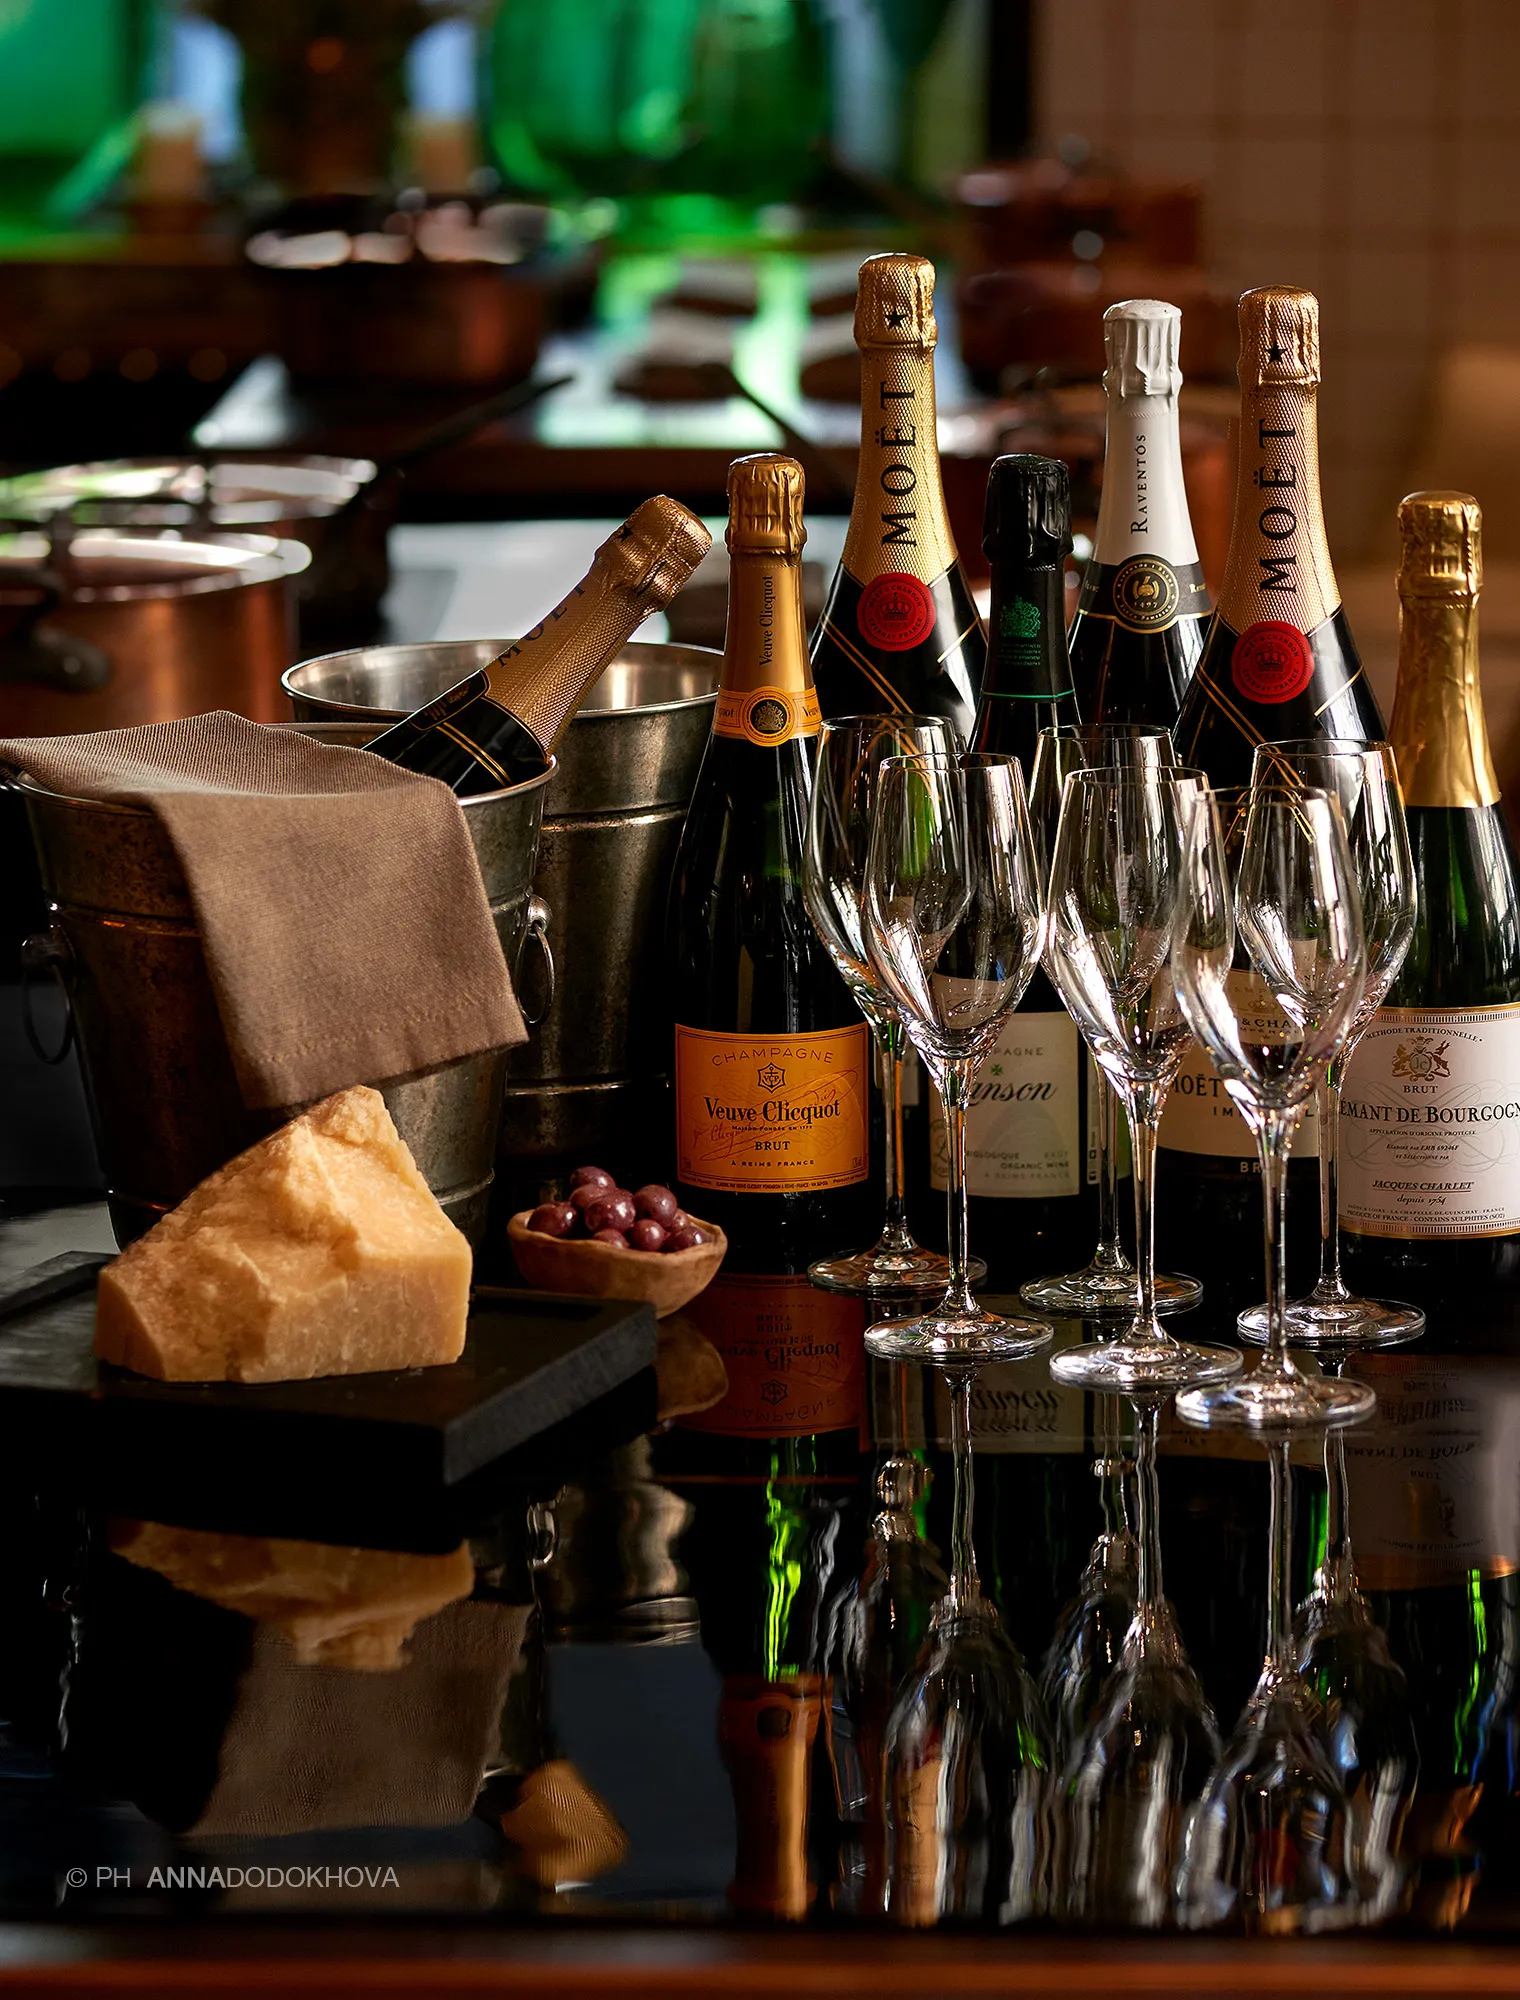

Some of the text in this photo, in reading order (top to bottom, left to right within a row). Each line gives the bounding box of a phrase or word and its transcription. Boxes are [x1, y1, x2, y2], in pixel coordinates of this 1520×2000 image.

[875, 380, 917, 547] MOËT
[1131, 434, 1149, 534] RAVENTÓS
[1253, 418, 1297, 594] MOËT
[759, 575, 776, 667] Veuve Clicquot
[1405, 1027, 1479, 1042] TRADITIONNELLE
[711, 1047, 834, 1067] CHAMPAGNE
[993, 1047, 1044, 1056] PAGNE
[969, 1081, 1059, 1106] anson
[1403, 1085, 1438, 1094] BRUT
[703, 1097, 841, 1125] Veuve Clicquot
[1340, 1097, 1393, 1122] ÉMANT
[1396, 1107, 1421, 1123] DE
[755, 1141, 790, 1151] BRUT
[1000, 1162, 1043, 1170] ORGANIC
[1240, 1161, 1262, 1173] BR
[1372, 1180, 1475, 1190] JACQUES CHARLET
[1397, 1194, 1425, 1205] depuis
[1451, 1214, 1488, 1222] SULPHITES
